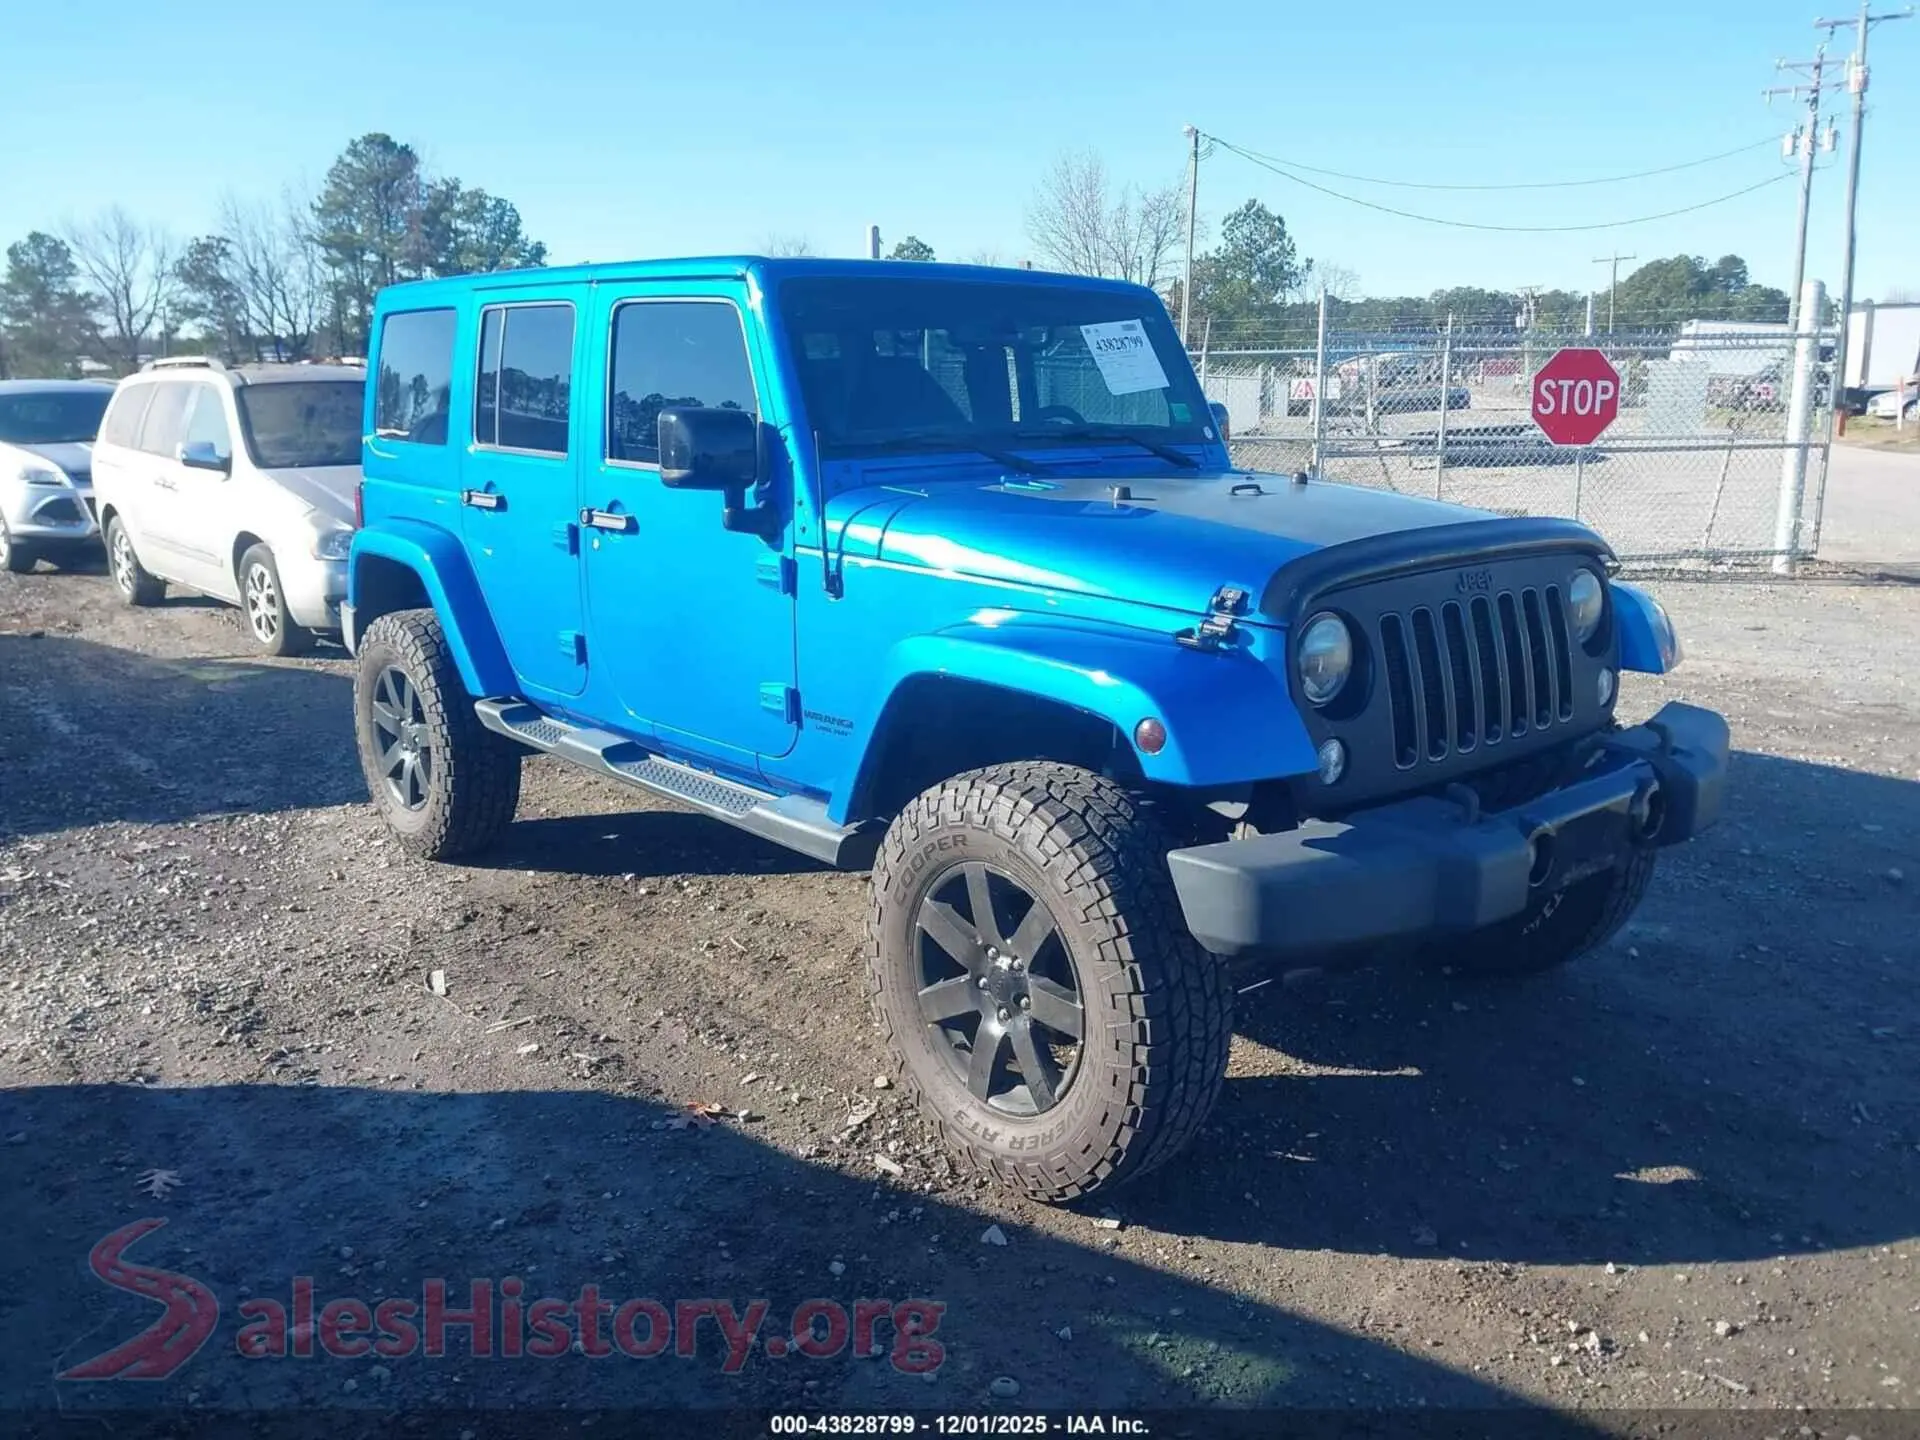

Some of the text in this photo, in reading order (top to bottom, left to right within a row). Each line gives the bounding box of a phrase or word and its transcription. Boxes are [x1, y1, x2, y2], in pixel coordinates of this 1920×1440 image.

[1095, 335, 1144, 352] 43828799
[1537, 379, 1614, 415] STOP
[1456, 569, 1495, 593] Jeep
[893, 834, 967, 907] COOPER
